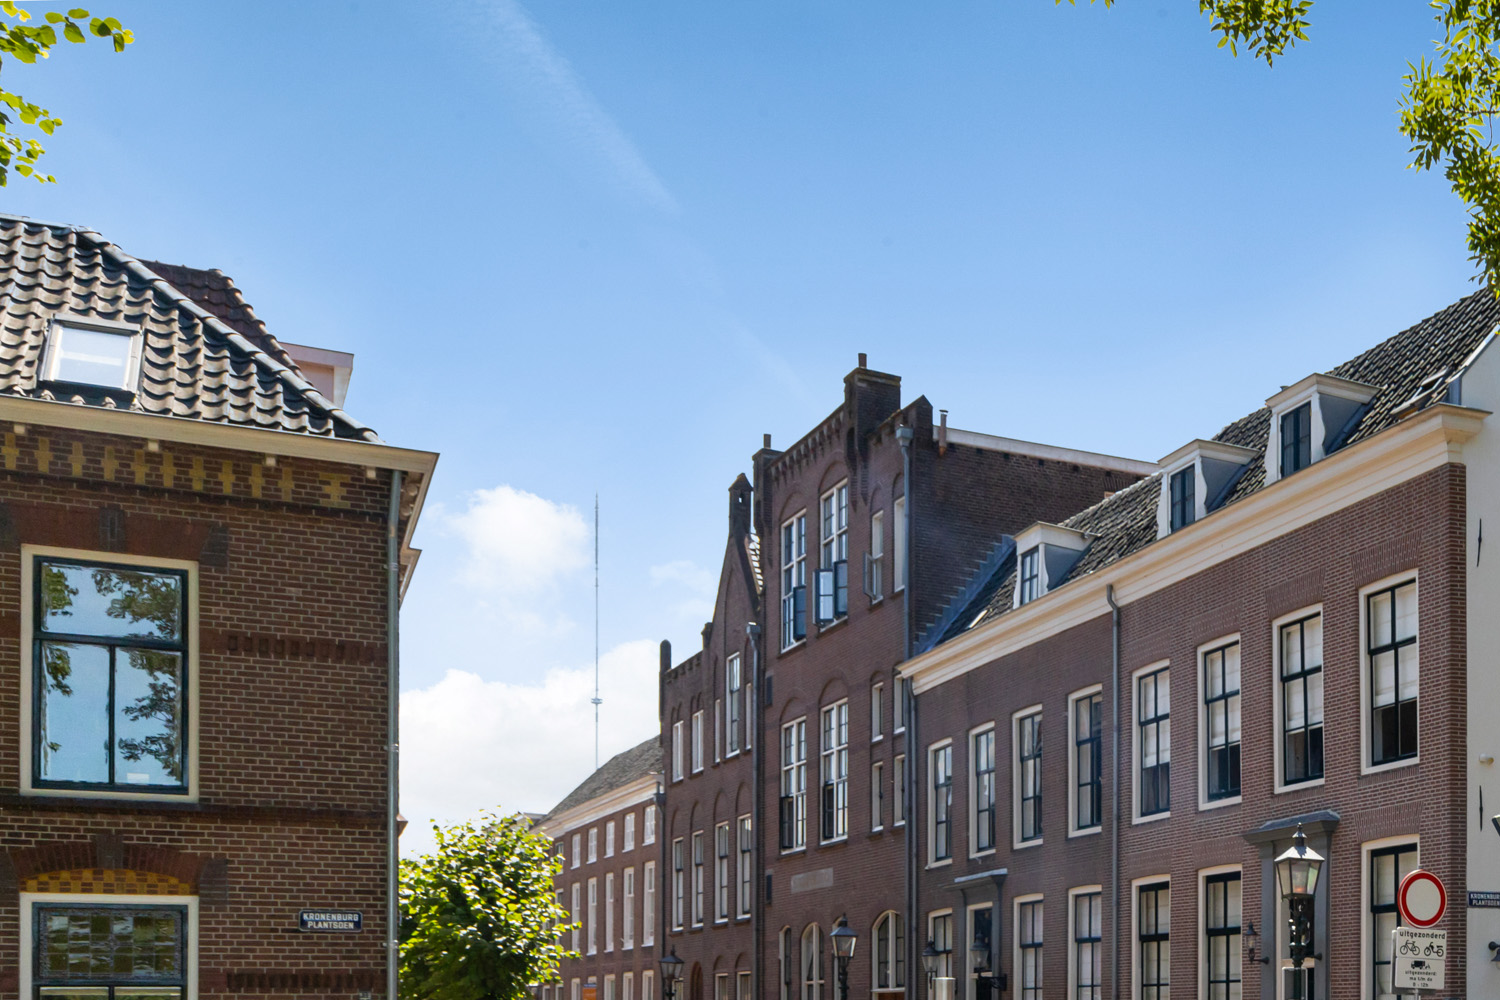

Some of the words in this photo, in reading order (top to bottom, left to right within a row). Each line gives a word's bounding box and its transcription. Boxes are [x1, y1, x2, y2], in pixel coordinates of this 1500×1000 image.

[303, 913, 359, 921] KRONENBURG
[307, 921, 354, 929] PLANTSOEN
[1400, 931, 1446, 939] uitgezonderd
